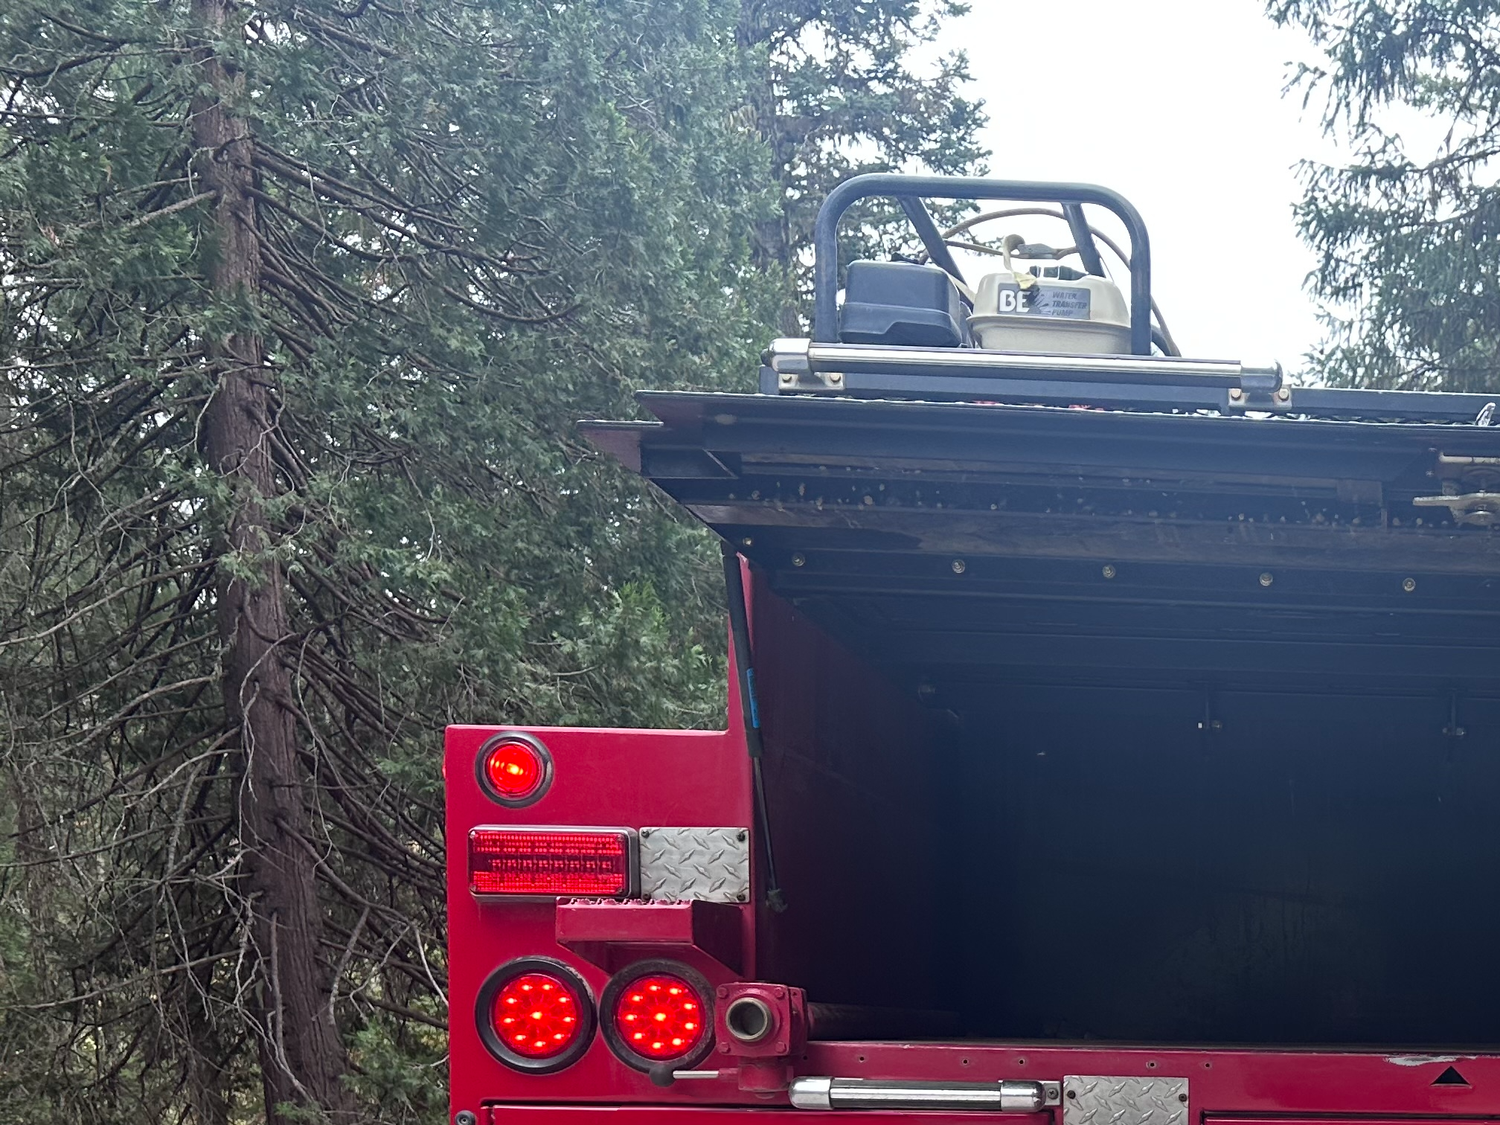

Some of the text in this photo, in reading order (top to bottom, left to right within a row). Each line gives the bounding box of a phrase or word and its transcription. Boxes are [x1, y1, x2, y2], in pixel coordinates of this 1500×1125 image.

[1053, 292, 1077, 300] WATER
[999, 290, 1031, 313] BE
[1053, 300, 1087, 310] TRANSFER
